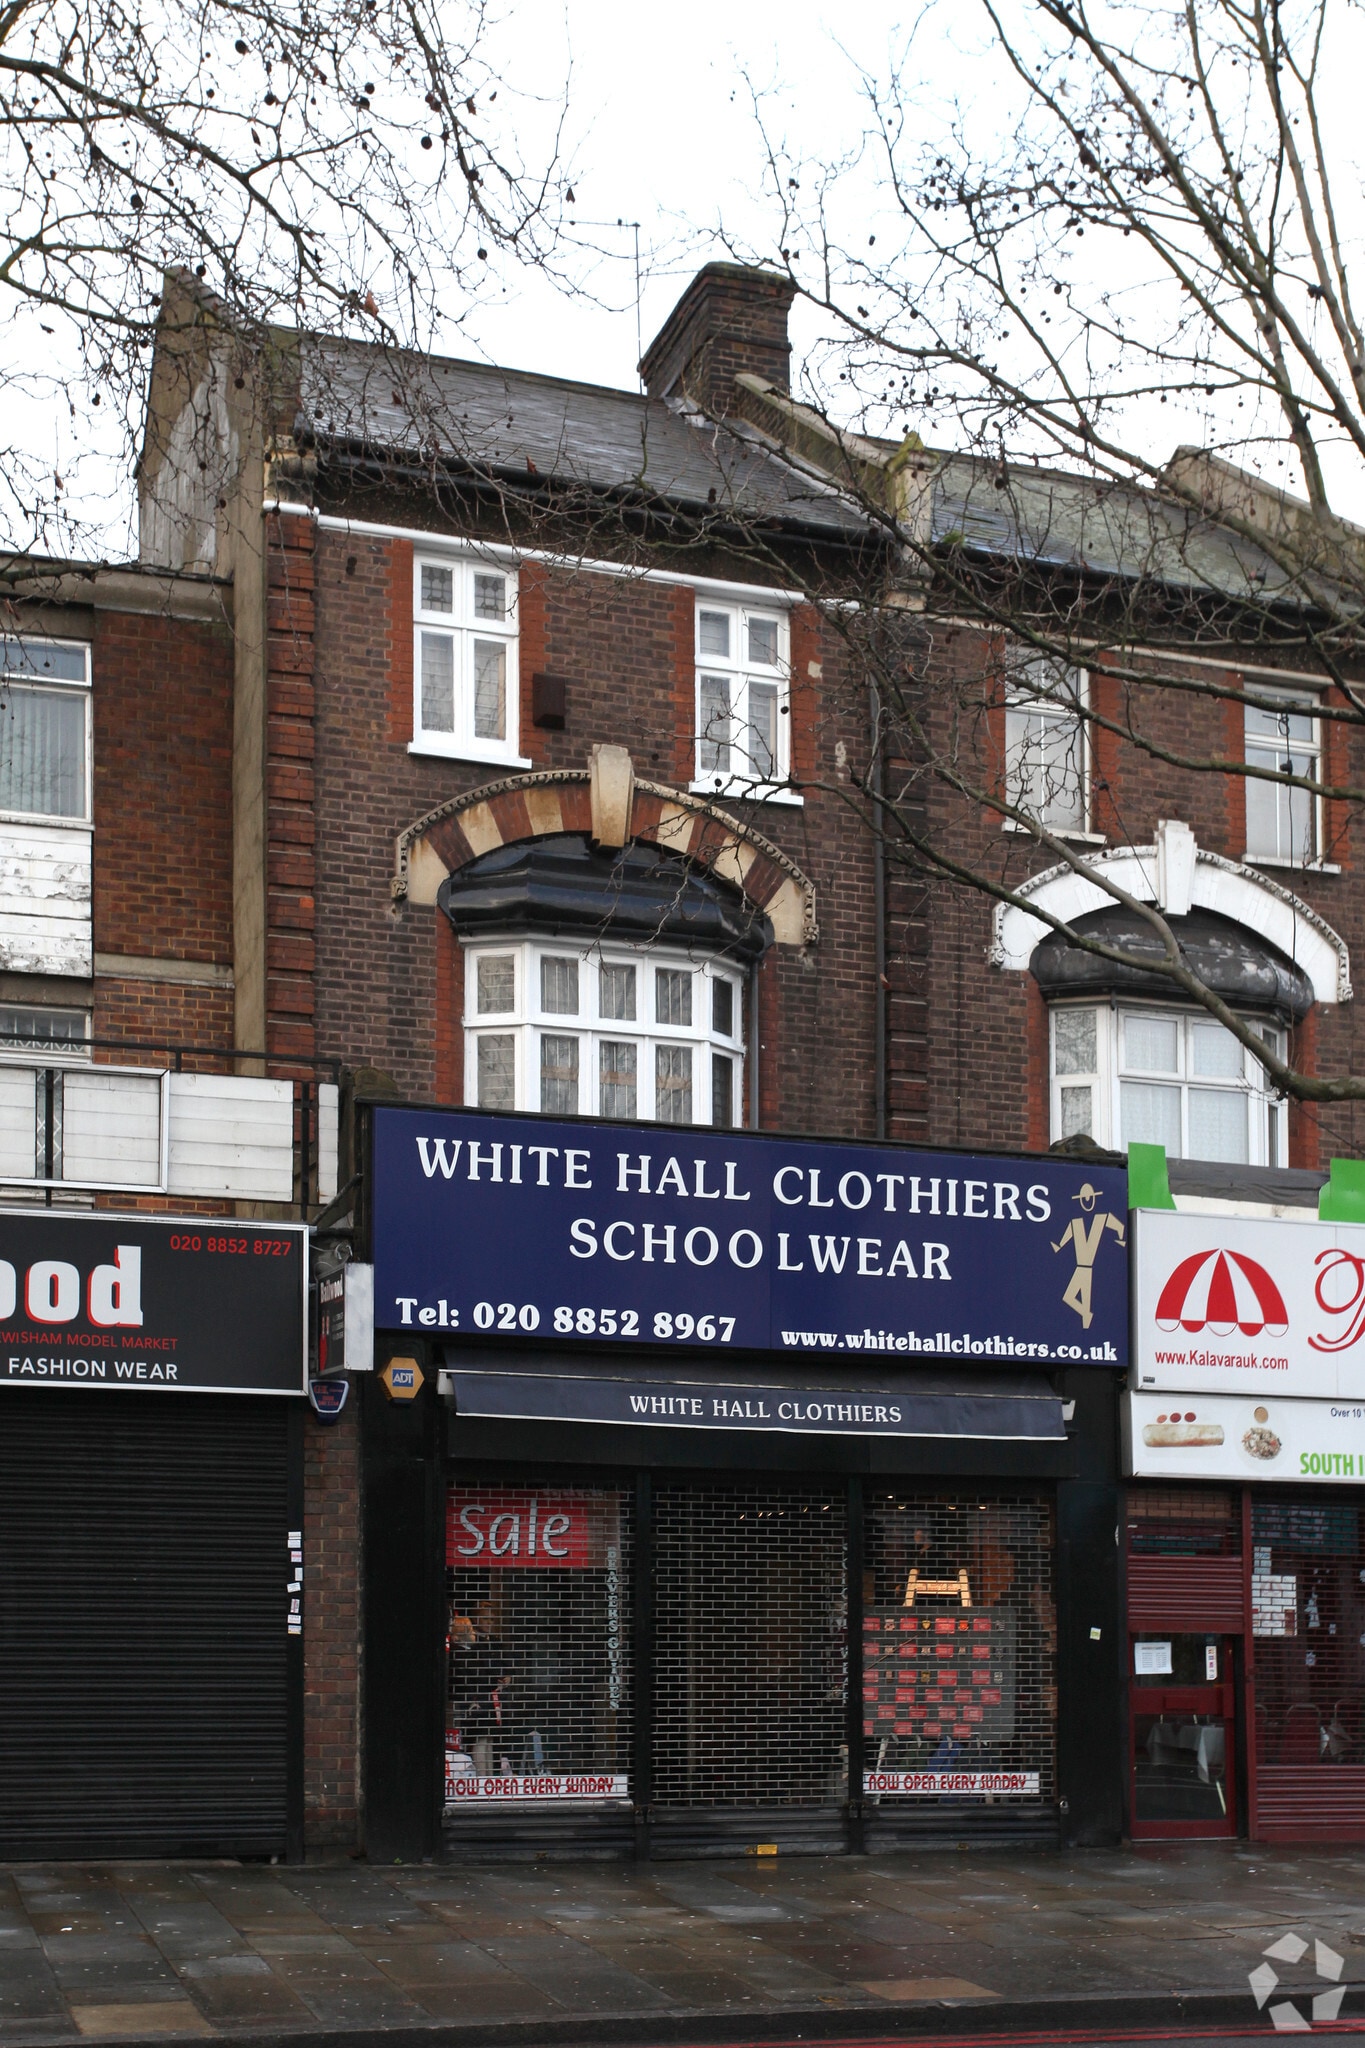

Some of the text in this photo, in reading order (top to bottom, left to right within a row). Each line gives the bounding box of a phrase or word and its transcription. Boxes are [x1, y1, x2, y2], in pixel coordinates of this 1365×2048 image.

[415, 1136, 1052, 1223] WHITE HALL CLOTHIERS
[170, 1235, 292, 1256] 020 8852 8727
[569, 1218, 952, 1281] SCHOOLWEAR
[396, 1297, 737, 1342] Tel: 020 8852 8967
[66, 1333, 118, 1348] MODEL
[121, 1336, 178, 1351] MARKET
[780, 1327, 1118, 1362] www.whitehallclothiers.co.uk
[8, 1357, 178, 1381] FASHION WEAR
[1155, 1349, 1289, 1371] www.Kalavarauk.com
[392, 1372, 414, 1384] ADT
[629, 1395, 902, 1423] WHITE HALL CLOTHIERS
[1330, 1407, 1350, 1418] Over
[1352, 1408, 1362, 1418] 10
[1299, 1452, 1354, 1476] SOUTH
[457, 1499, 571, 1557] Sale
[447, 1776, 614, 1796] NOW OPEN EVERY SUNDAY
[869, 1774, 1026, 1790] NOW OPEN EVERY SUNDAY
